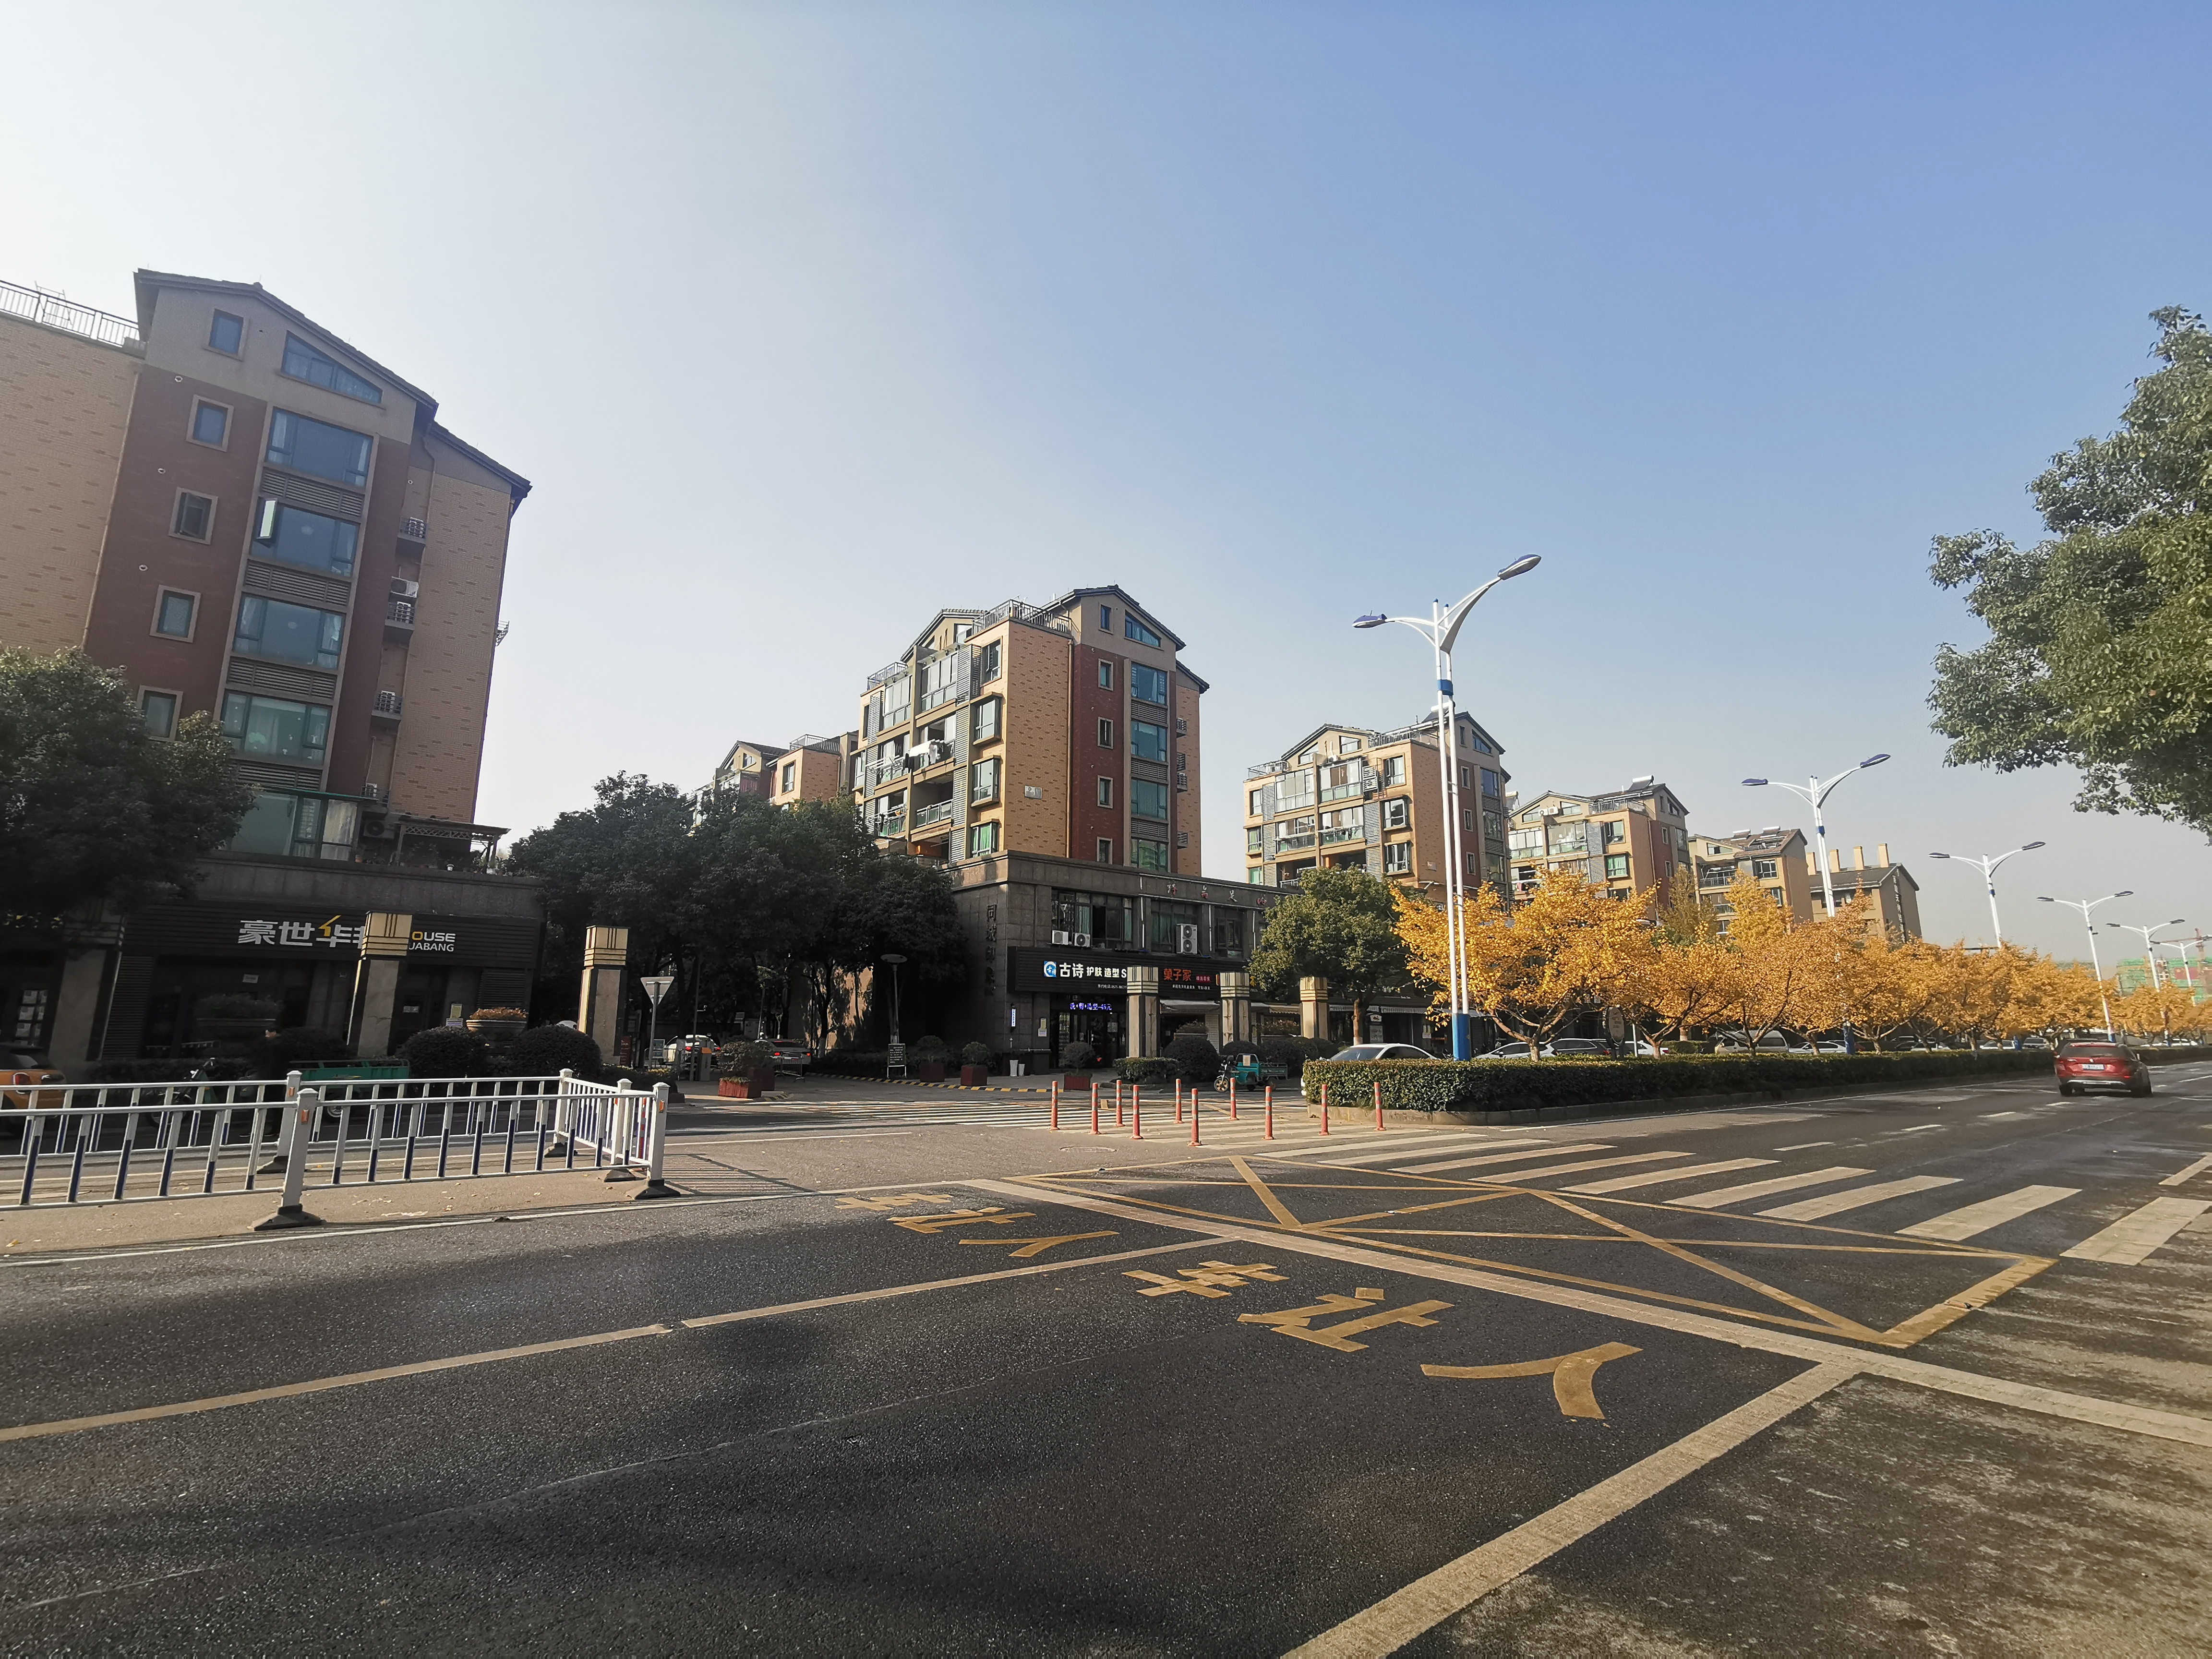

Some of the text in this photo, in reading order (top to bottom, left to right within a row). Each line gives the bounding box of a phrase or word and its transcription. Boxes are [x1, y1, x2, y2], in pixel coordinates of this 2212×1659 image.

[1059, 962, 1084, 978] 古诗
[1086, 966, 1103, 977] 护肤
[1104, 967, 1120, 978] 造型
[1122, 1260, 1644, 1419] 车让人
